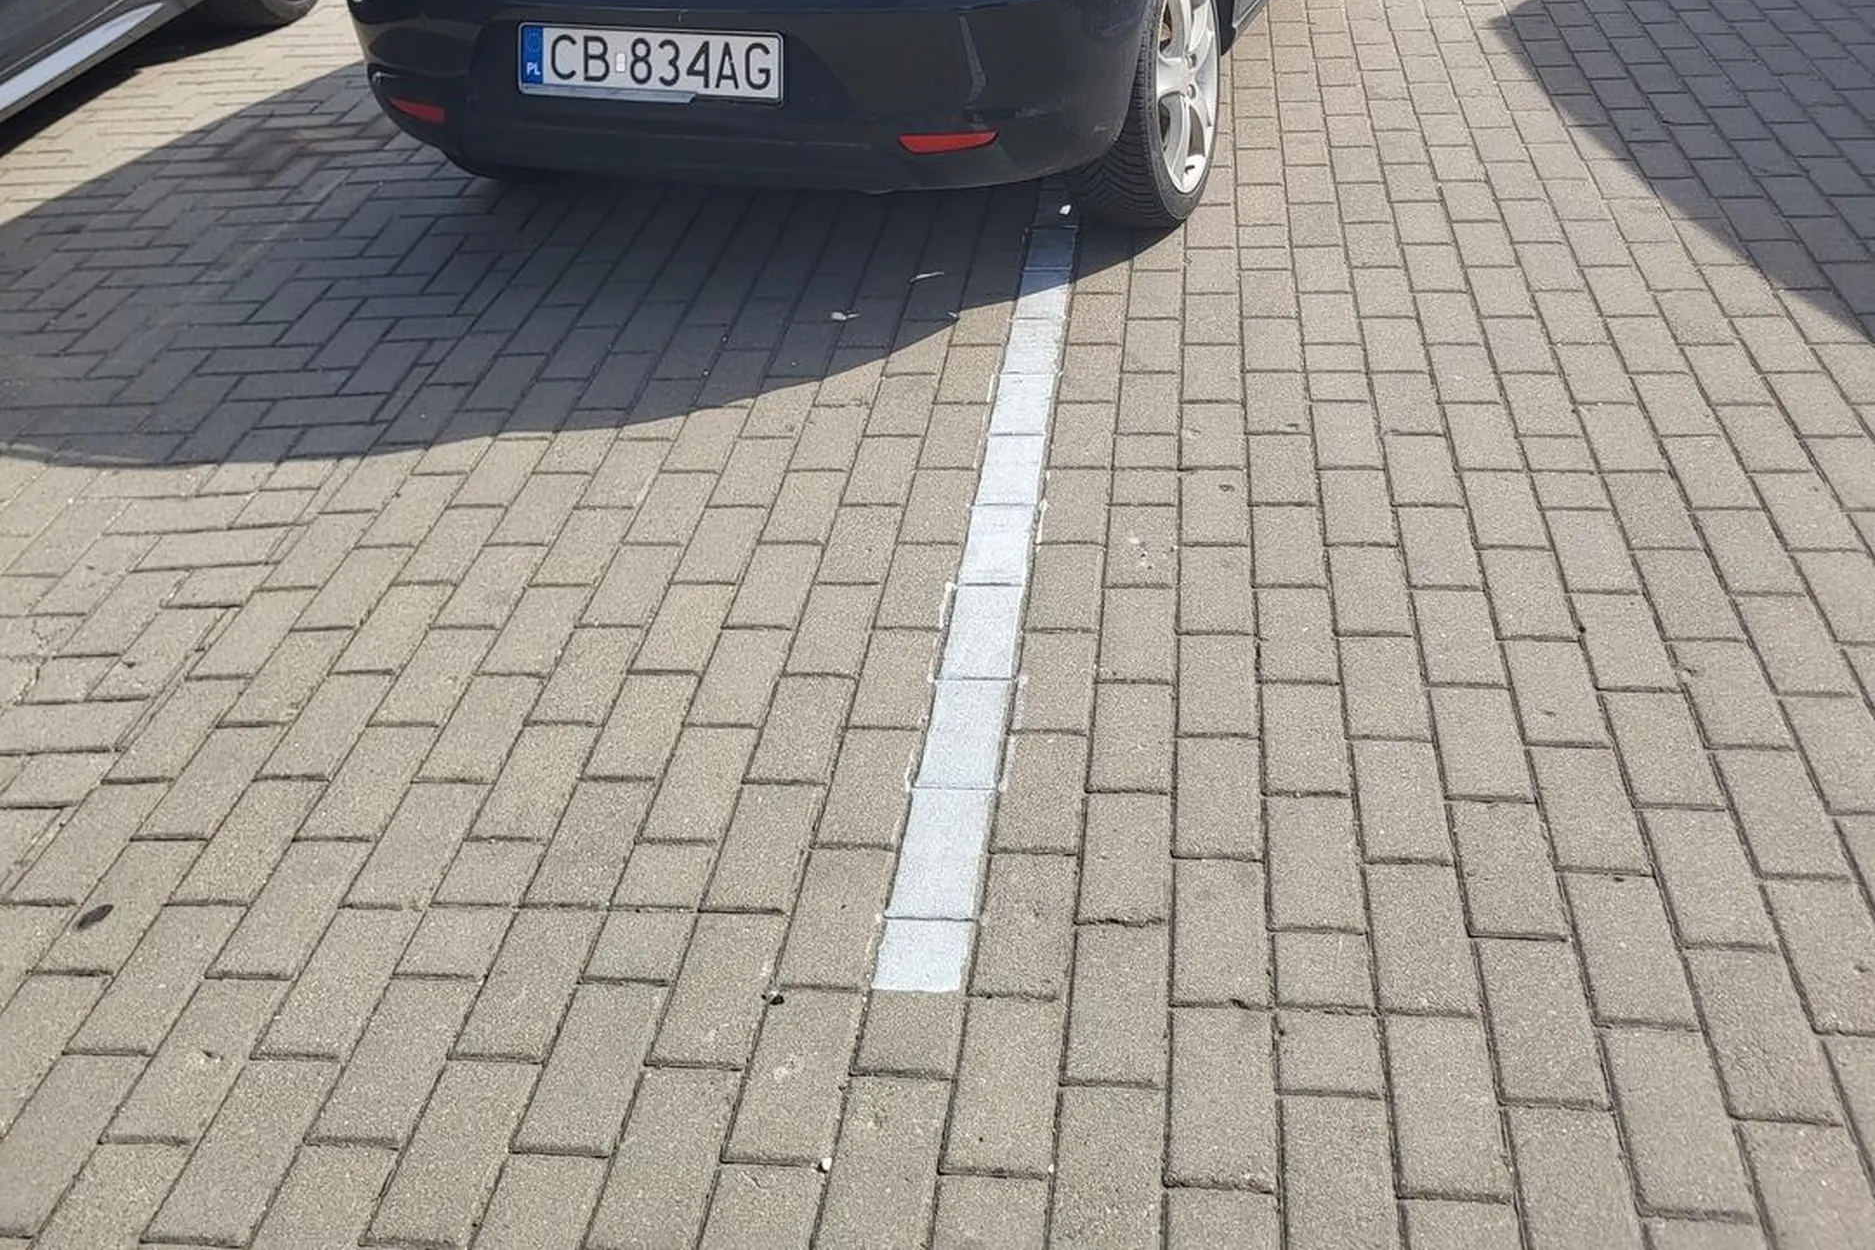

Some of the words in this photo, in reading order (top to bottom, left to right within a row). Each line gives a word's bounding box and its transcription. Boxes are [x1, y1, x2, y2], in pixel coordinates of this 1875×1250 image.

[526, 61, 541, 76] PL
[550, 34, 610, 82] CB
[629, 37, 772, 91] 834AG
